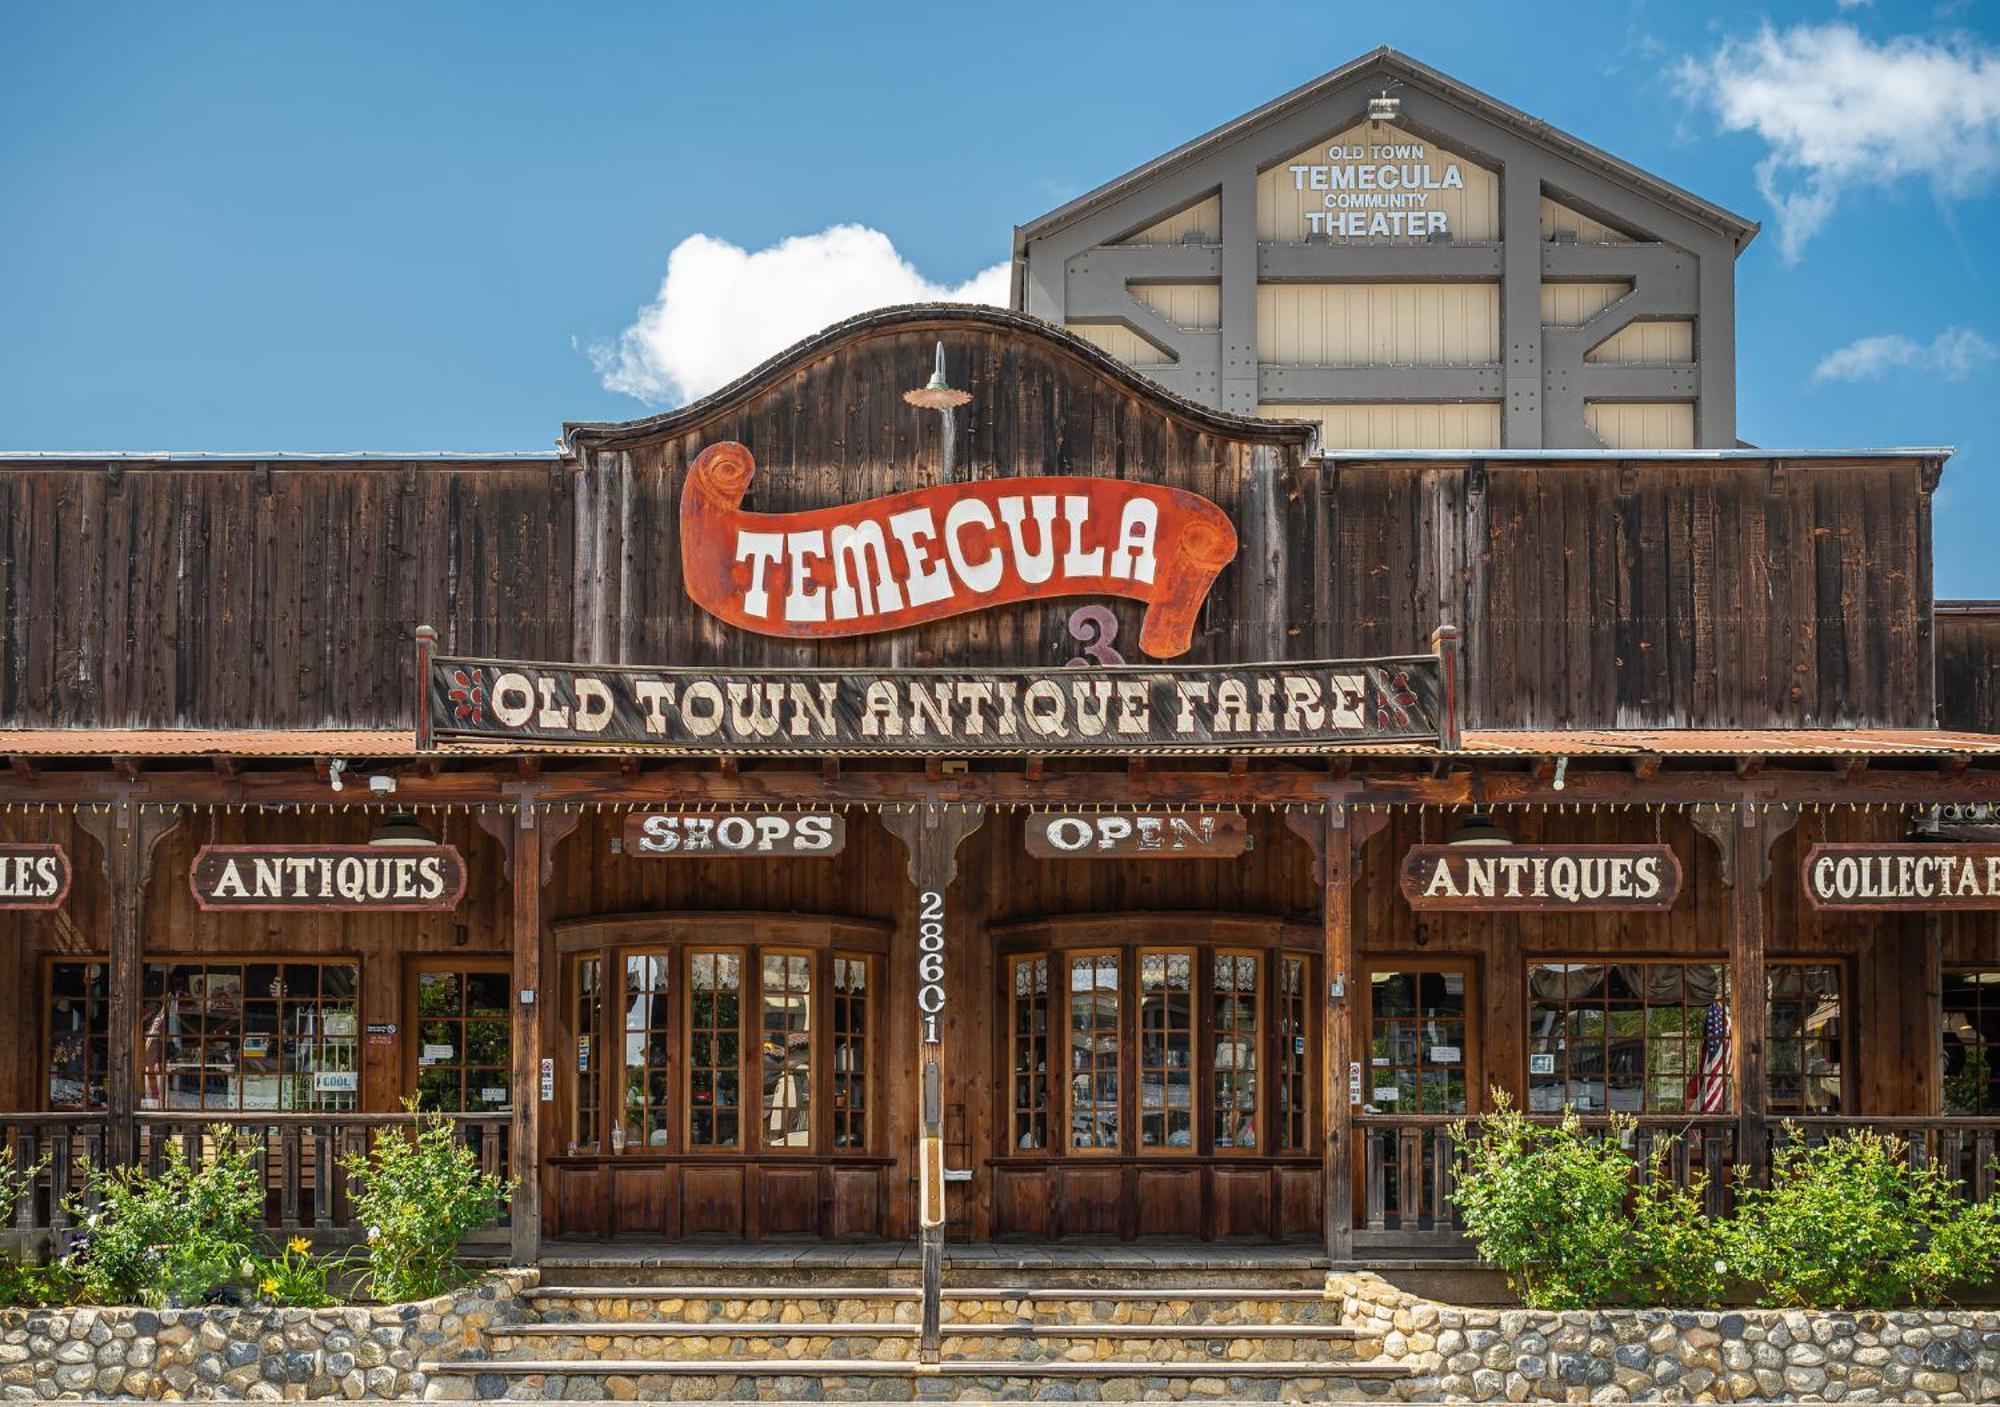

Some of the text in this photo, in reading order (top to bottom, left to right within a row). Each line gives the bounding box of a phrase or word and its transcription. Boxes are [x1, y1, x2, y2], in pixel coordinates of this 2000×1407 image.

[1328, 145, 1424, 160] OLD TOWN
[1289, 165, 1463, 190] TEMECULA
[1325, 193, 1428, 208] COMMUNITY
[1305, 211, 1448, 236] THEATER
[736, 496, 1158, 621] TEMECULA
[491, 672, 1365, 738] OLD TOWN ANTIQUE FAIRE
[639, 816, 833, 851] SHOPS
[1046, 816, 1216, 851] OPEN
[212, 857, 445, 902] ANTIQUES
[1424, 856, 1661, 903] ANTIQUES
[918, 891, 946, 1043] 28601
[323, 1075, 351, 1087] COOL
